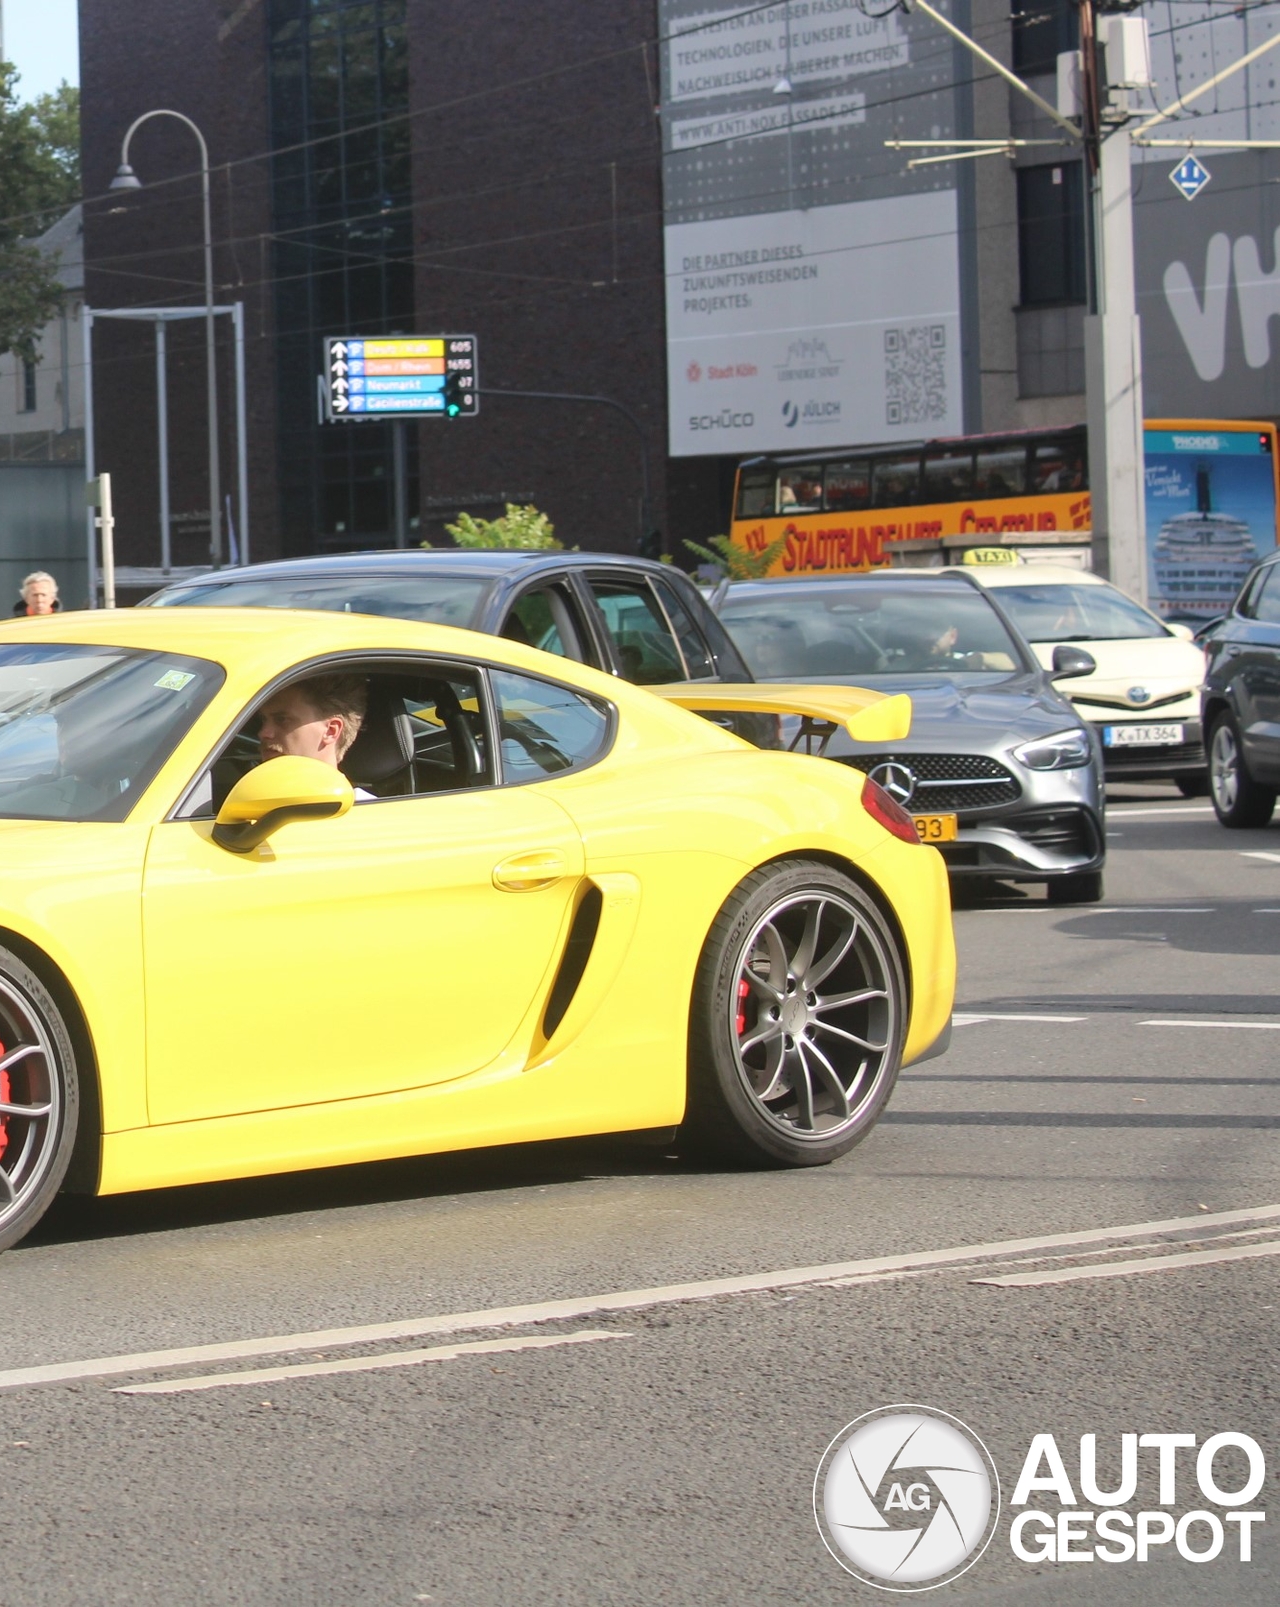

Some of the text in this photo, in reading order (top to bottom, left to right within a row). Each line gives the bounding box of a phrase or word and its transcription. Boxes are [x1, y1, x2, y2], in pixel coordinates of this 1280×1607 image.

[704, 14, 745, 34] TESTEN
[748, 11, 765, 27] AN
[767, 3, 809, 24] DIESER
[811, 0, 866, 17] FASSAD
[677, 18, 889, 67] TECHNOLOGIEN, DIE UNSERE LUFT
[677, 45, 904, 93] NACHWEISLICH SAUBERER MACHEN.
[683, 244, 803, 271] DIE PARTNER DIESES
[683, 264, 818, 292] ZUKUNFTSWEISENDEN
[683, 294, 751, 314] PROJEKTES:
[450, 341, 471, 353] 605
[367, 361, 391, 372] Dom
[707, 362, 758, 380] Stadt Köln
[367, 379, 422, 391] Neumarkt
[802, 400, 841, 418] JÜLICH
[689, 408, 754, 431] SCHÜCO
[975, 550, 1013, 563] TAXI
[1116, 726, 1176, 741] K TX 364
